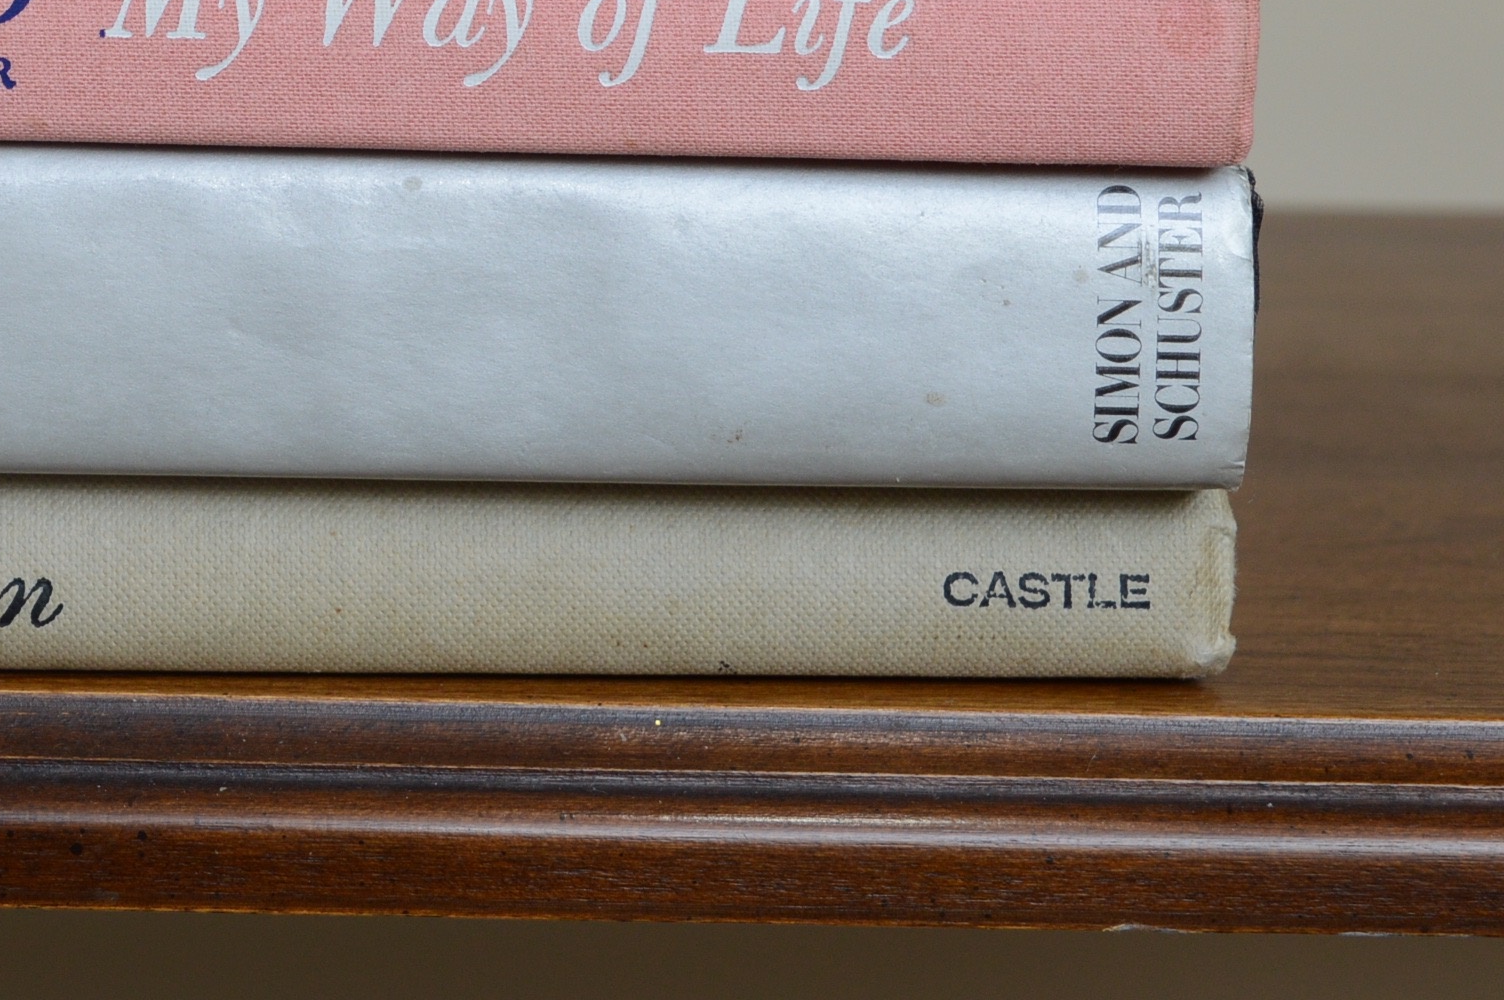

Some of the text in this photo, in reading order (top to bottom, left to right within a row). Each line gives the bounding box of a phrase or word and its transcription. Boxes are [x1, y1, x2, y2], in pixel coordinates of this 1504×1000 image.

[1091, 184, 1144, 445] SIMON AND
[1151, 191, 1204, 442] SCHUSTER
[942, 571, 1151, 610] CASTLE
